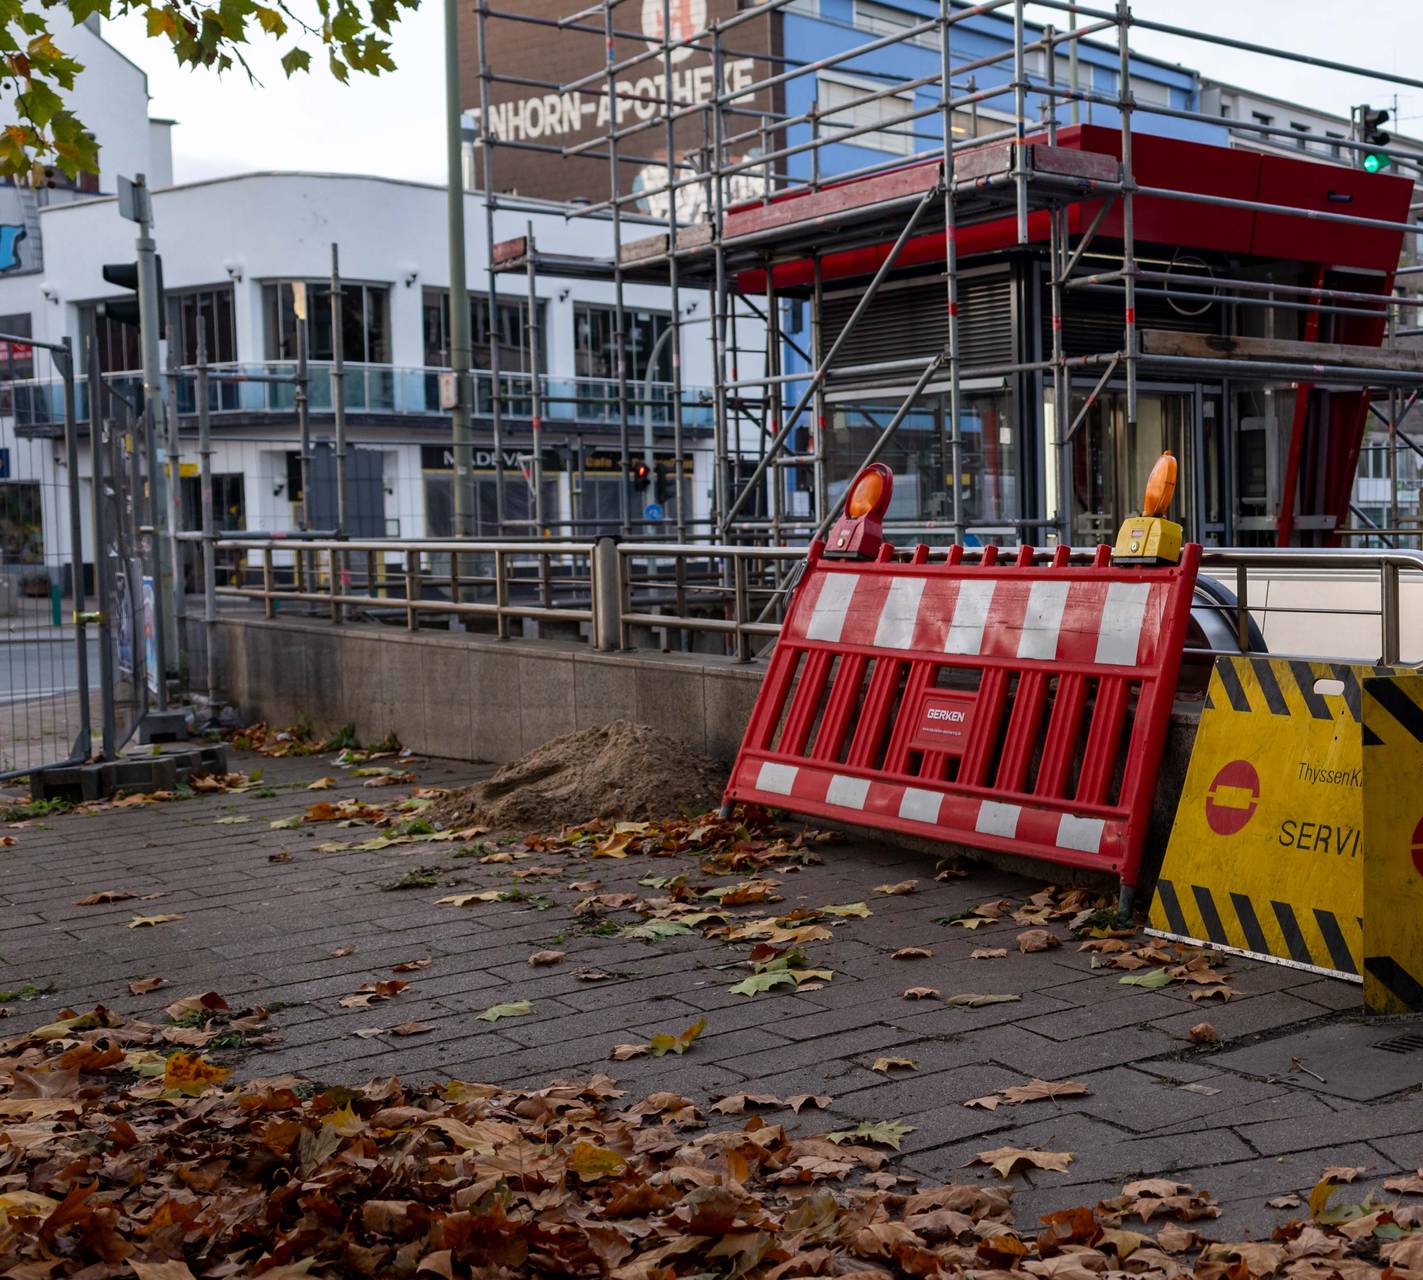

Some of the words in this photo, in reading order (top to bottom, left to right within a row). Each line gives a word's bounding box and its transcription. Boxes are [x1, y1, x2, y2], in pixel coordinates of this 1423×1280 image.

[463, 59, 754, 147] NHORN-APOTHEKE
[927, 708, 965, 722] GERKEN
[1296, 762, 1362, 788] ThyssenK
[1278, 819, 1362, 858] SERVI
